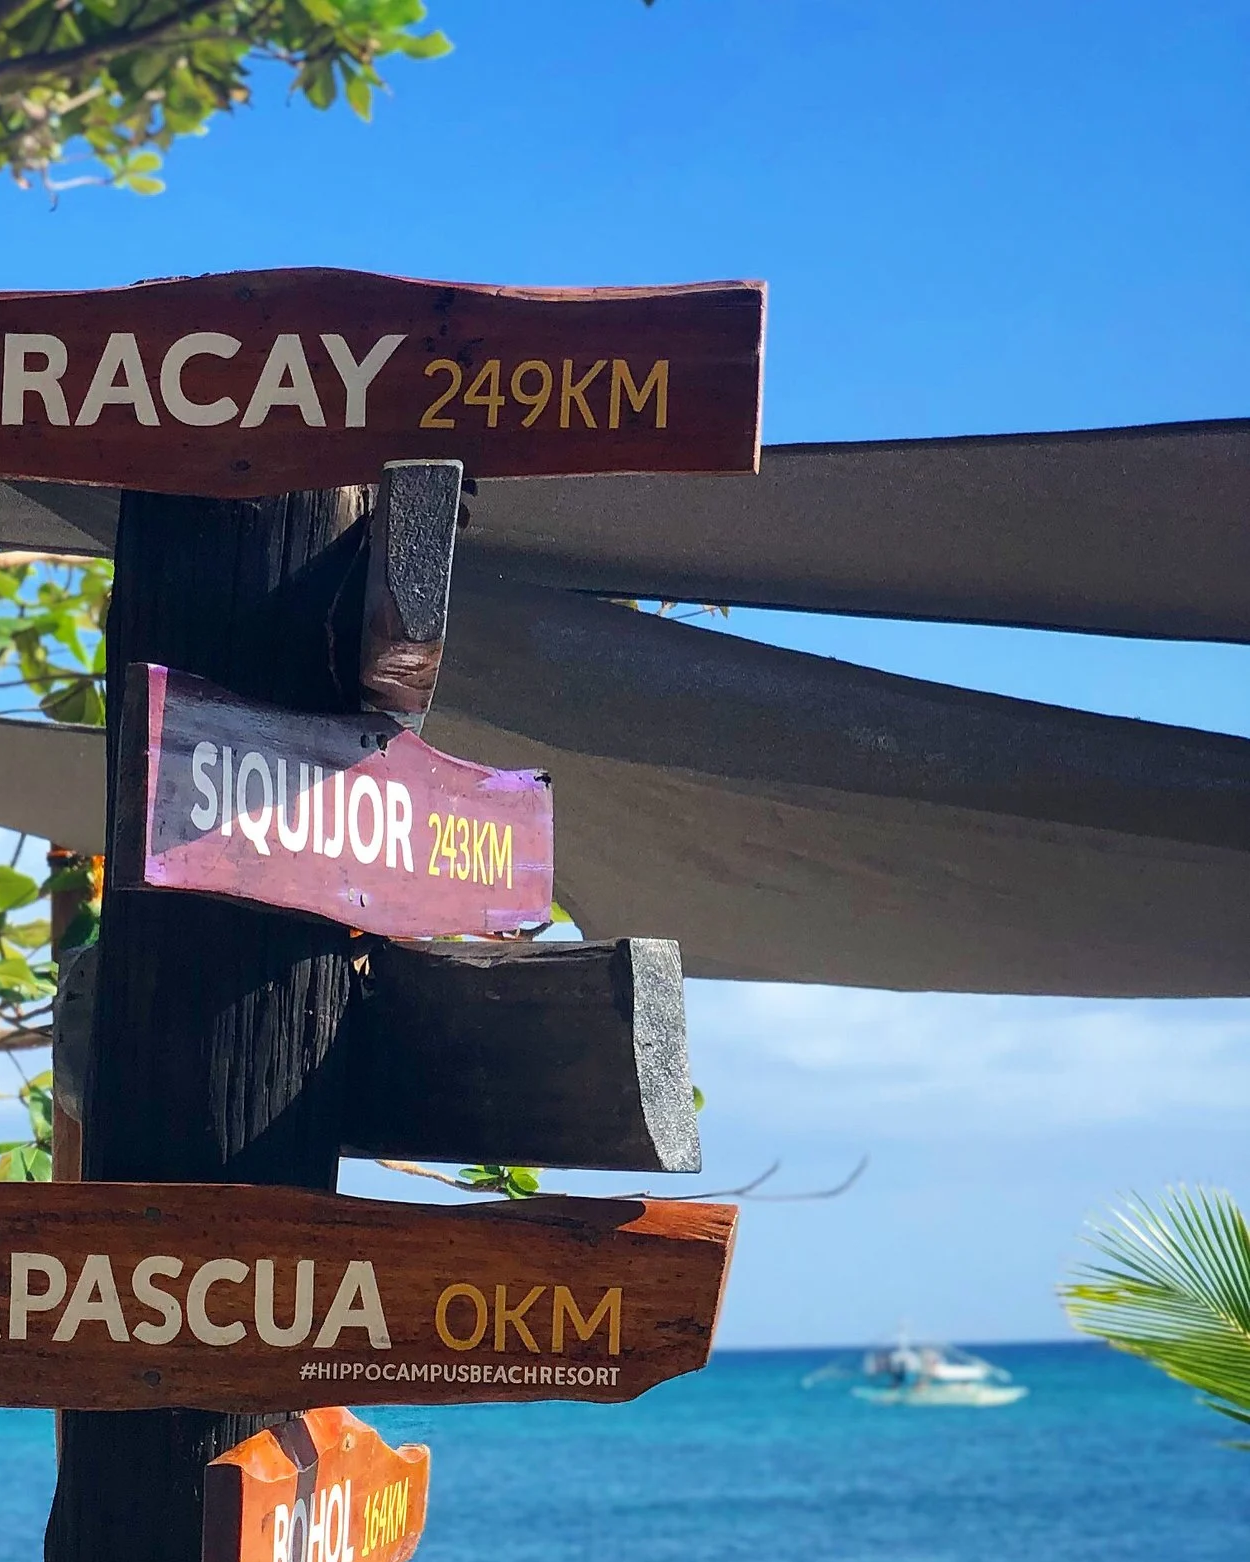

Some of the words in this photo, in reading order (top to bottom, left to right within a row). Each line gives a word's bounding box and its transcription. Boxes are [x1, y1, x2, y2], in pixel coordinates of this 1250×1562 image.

[419, 357, 669, 431] 249KM
[190, 741, 414, 872] SIQUIJOR
[428, 812, 513, 890] 243KM
[299, 1363, 620, 1387] #HIPPOCAMPUSBEACHRESORT
[362, 1477, 409, 1557] 164KM
